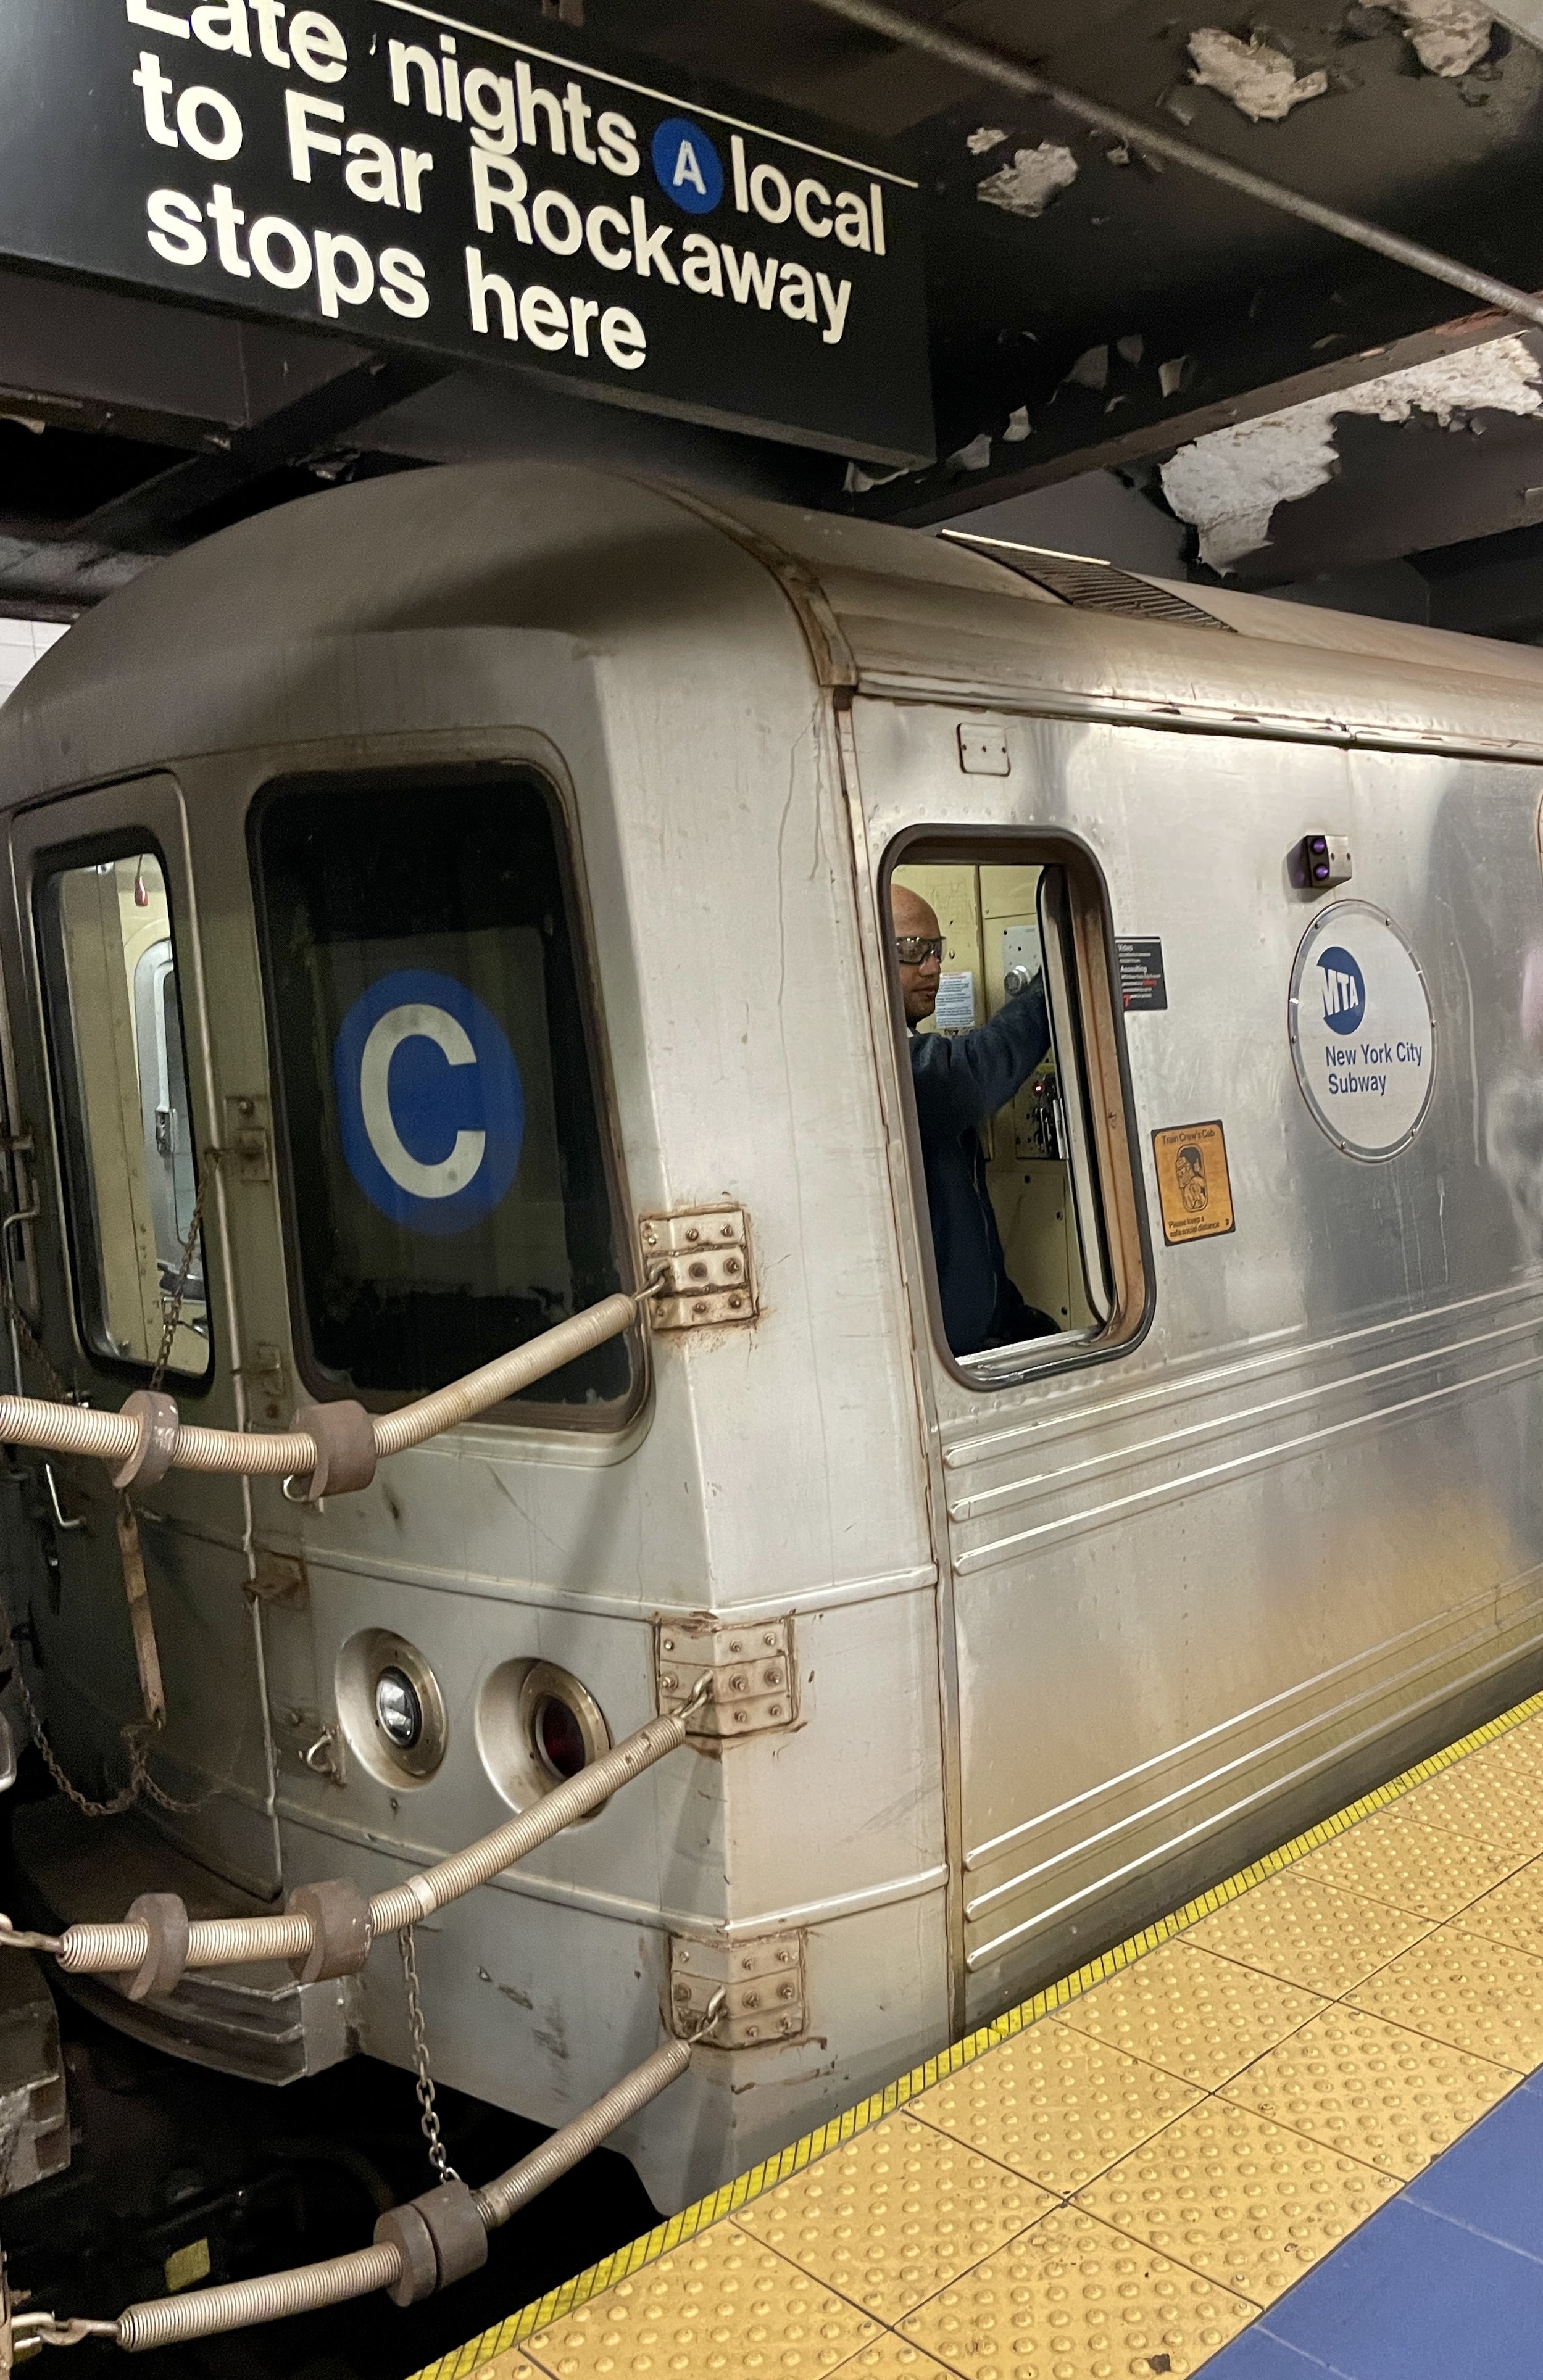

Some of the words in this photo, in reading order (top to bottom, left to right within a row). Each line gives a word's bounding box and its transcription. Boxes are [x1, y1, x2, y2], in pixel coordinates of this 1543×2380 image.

[133, 51, 243, 161] to
[285, 89, 433, 214] Far
[471, 146, 851, 346] Rockaway
[388, 34, 641, 177] nights
[672, 139, 706, 194] A
[731, 135, 886, 255] local
[147, 183, 430, 319] stops
[465, 246, 647, 370] here
[1319, 965, 1360, 1018] MTA
[361, 1003, 486, 1198] C
[1325, 1045, 1357, 1067] New
[1360, 1043, 1392, 1064] York
[1396, 1042, 1423, 1066] City
[1328, 1072, 1386, 1097] Subway
[1162, 1134, 1179, 1145] Train
[1179, 1131, 1201, 1142] Crew's
[1202, 1129, 1215, 1138] Cab
